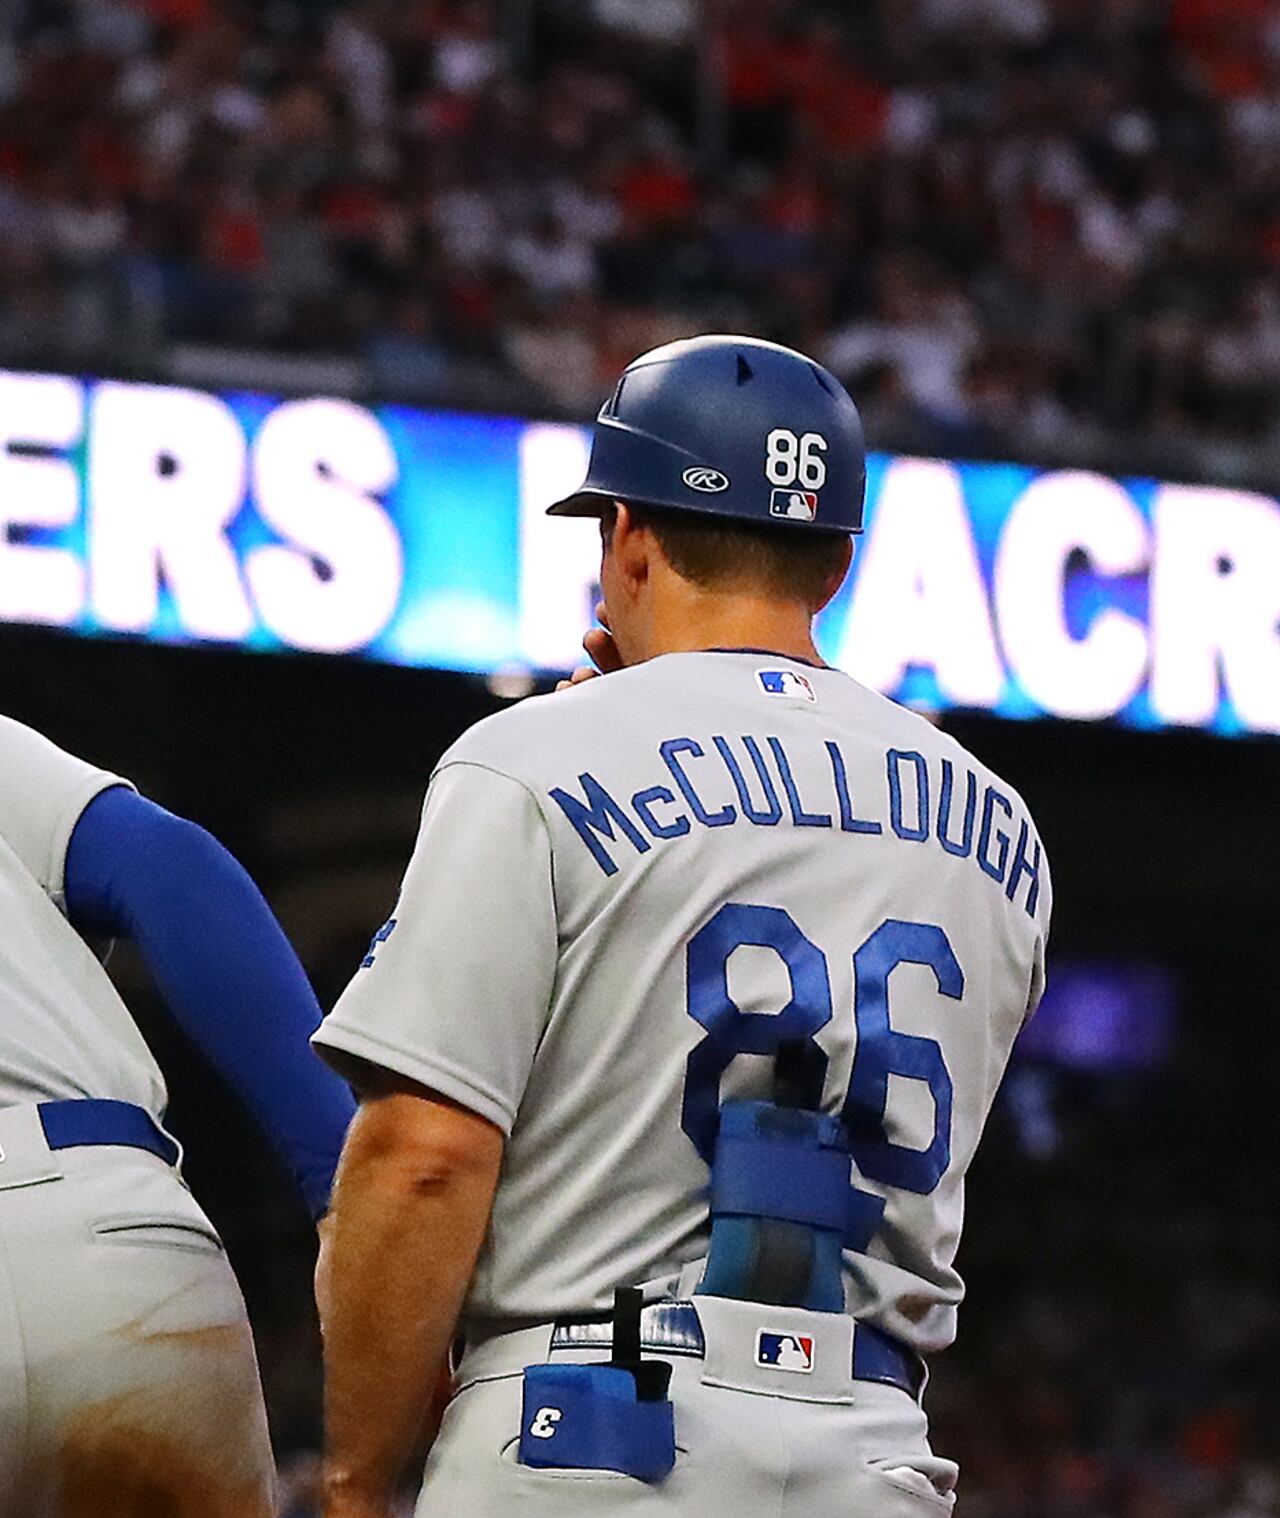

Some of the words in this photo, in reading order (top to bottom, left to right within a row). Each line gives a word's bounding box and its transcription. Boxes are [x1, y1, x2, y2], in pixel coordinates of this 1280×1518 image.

[518, 420, 1280, 735] ACR
[765, 428, 828, 489] 86
[550, 736, 1041, 919] McCULLOUGH
[681, 902, 965, 1196] 86
